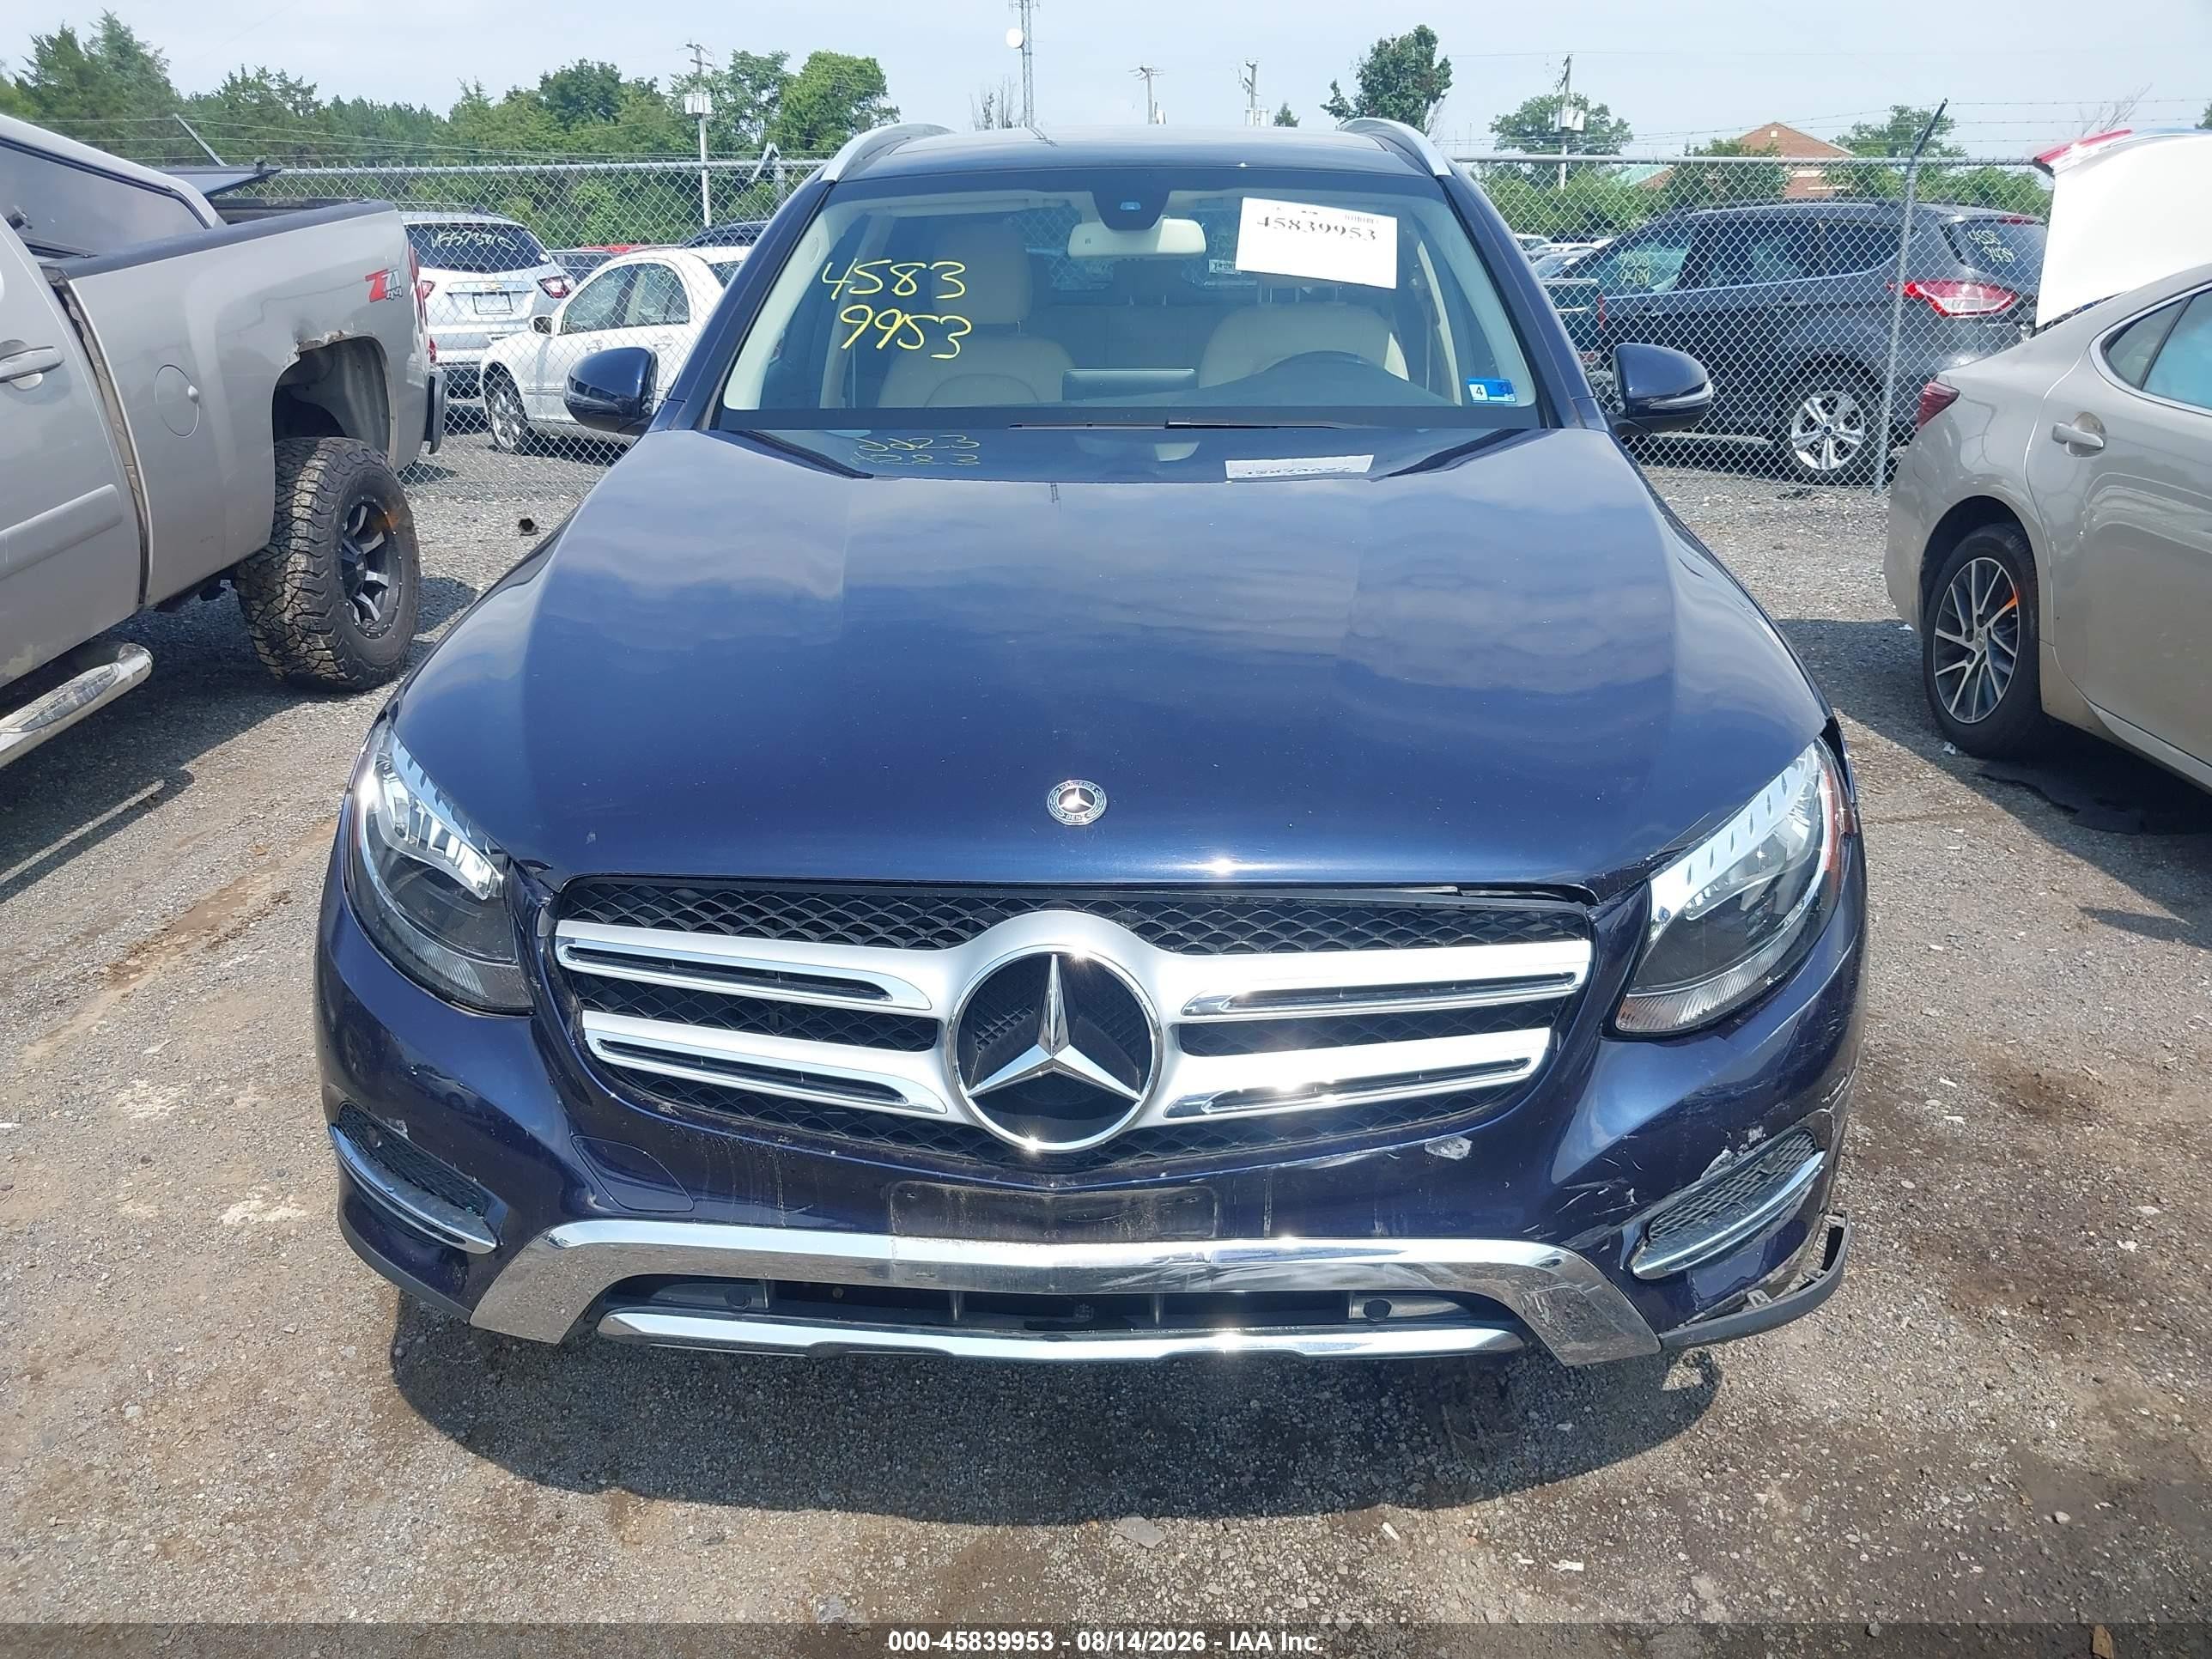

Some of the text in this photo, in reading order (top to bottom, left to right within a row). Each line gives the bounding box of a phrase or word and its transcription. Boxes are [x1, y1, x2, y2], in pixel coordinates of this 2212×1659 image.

[822, 258, 967, 301] 4583
[840, 304, 972, 360] 9953
[1475, 386, 1484, 397] 4
